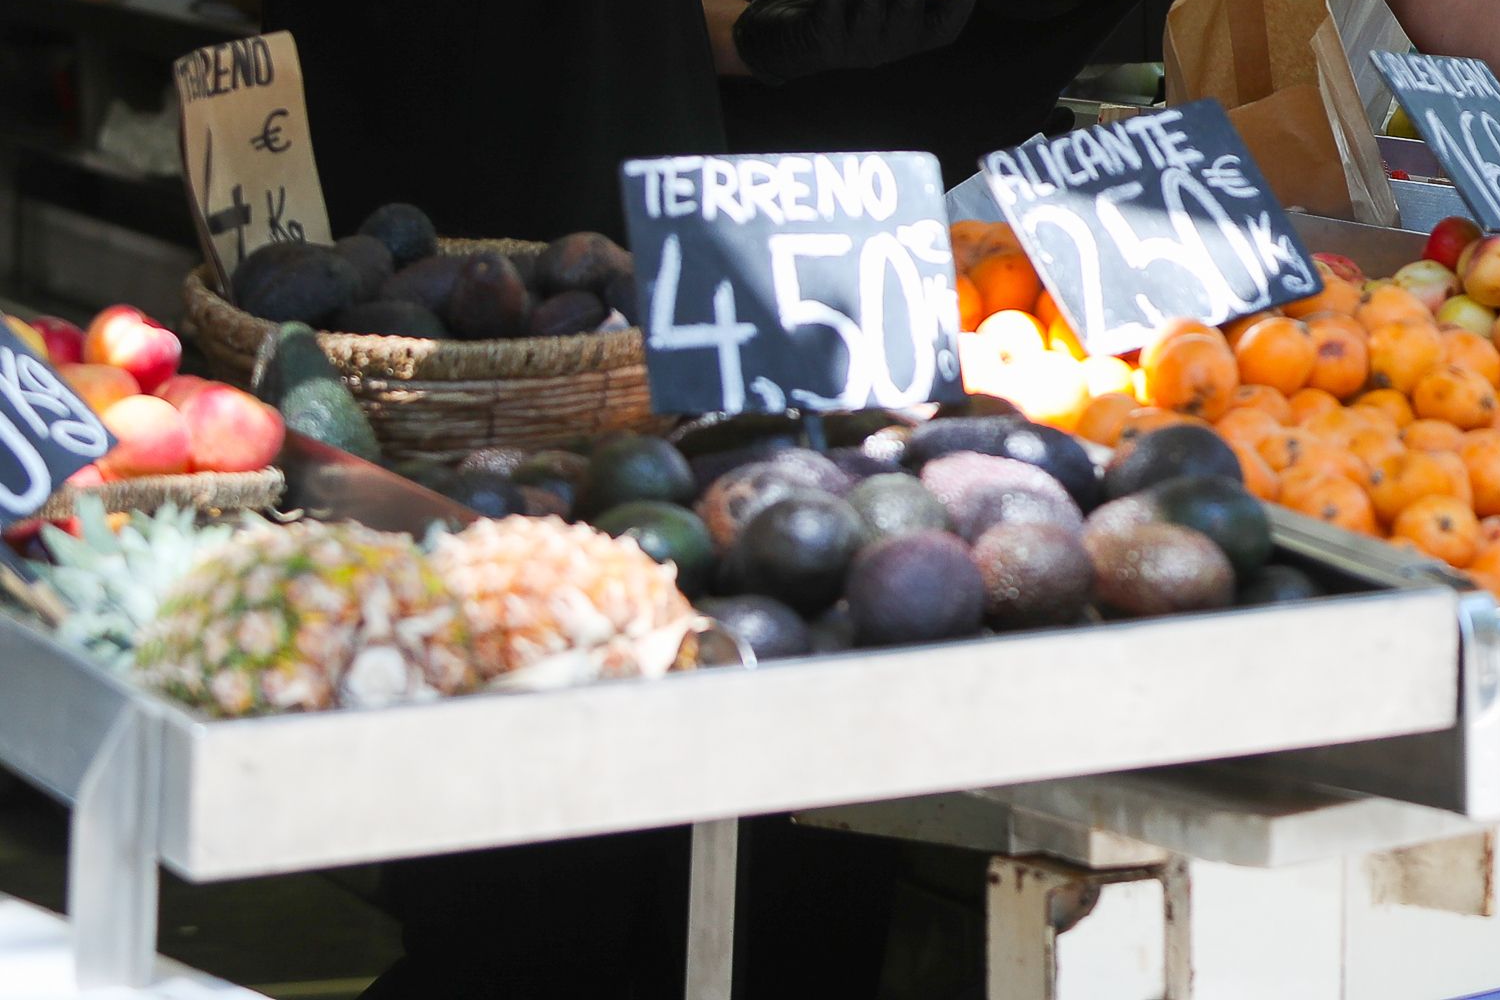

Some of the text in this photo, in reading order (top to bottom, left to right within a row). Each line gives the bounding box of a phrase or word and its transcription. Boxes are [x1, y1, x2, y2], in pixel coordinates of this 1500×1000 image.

[251, 108, 292, 153] €
[985, 109, 1204, 205] ALICANTE
[623, 155, 898, 226] TERRENO
[1202, 154, 1260, 199] €
